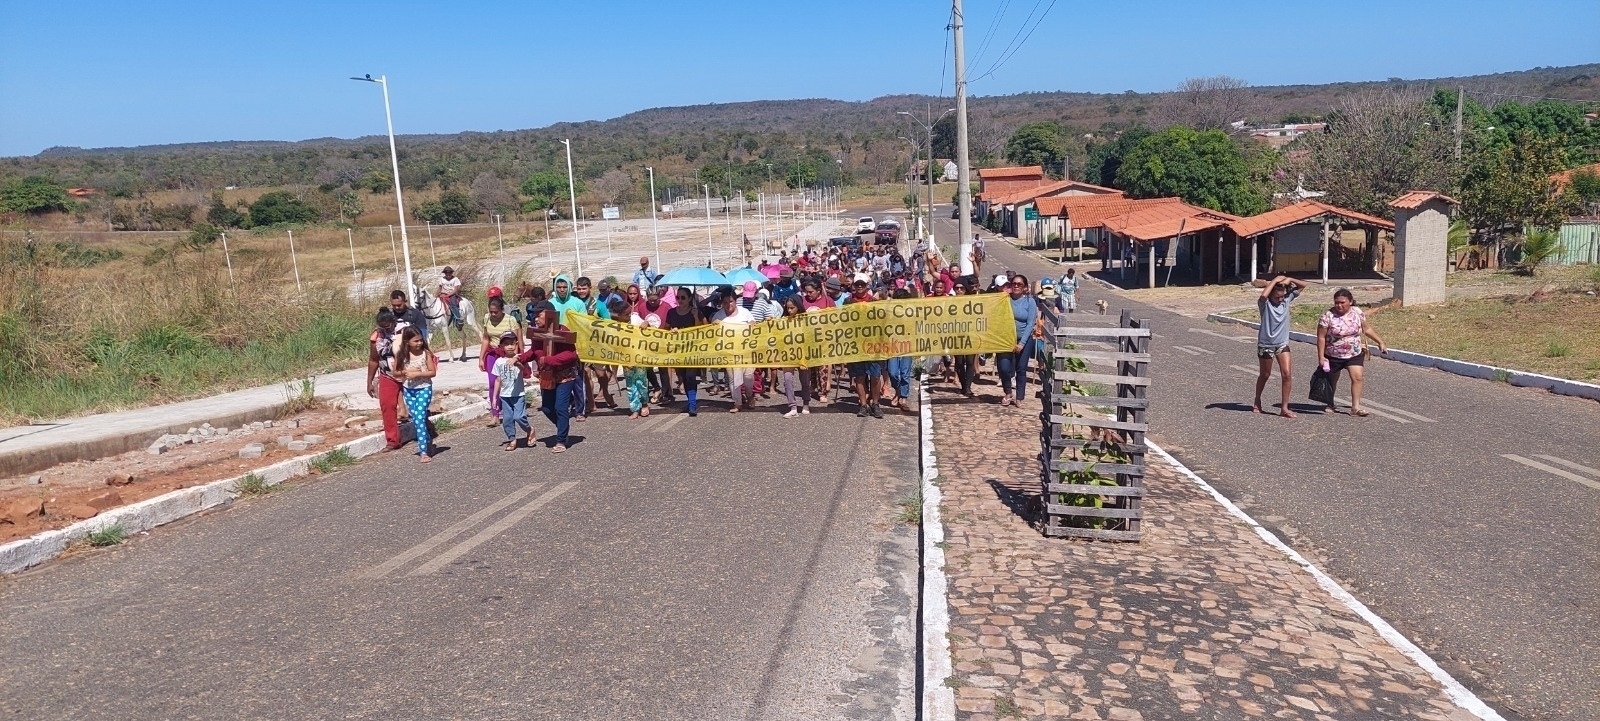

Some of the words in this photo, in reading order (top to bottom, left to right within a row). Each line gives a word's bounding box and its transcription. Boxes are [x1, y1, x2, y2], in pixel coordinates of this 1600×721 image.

[638, 339, 660, 352] na
[666, 341, 708, 353] trilha
[714, 340, 734, 351] da
[741, 336, 758, 350] fé
[768, 336, 776, 346] e
[783, 331, 805, 345] da
[814, 324, 911, 343] Esperança.
[915, 319, 972, 335] Monsenhor
[976, 317, 988, 332] Gil
[641, 325, 735, 341] Caminhada
[742, 325, 762, 337] da
[867, 306, 886, 320] do
[893, 304, 943, 320] Corpo
[948, 304, 958, 315] e
[963, 301, 983, 315] da
[600, 348, 631, 364] Santa
[635, 353, 659, 366] Cruz
[663, 356, 681, 366] dos
[751, 352, 763, 364] De
[765, 348, 780, 363] 22
[781, 350, 788, 361] a
[789, 347, 802, 361] 30
[805, 344, 825, 360] Jul.
[828, 341, 859, 357] 2023
[916, 338, 931, 352] IDA
[940, 335, 972, 350] VOLTA
